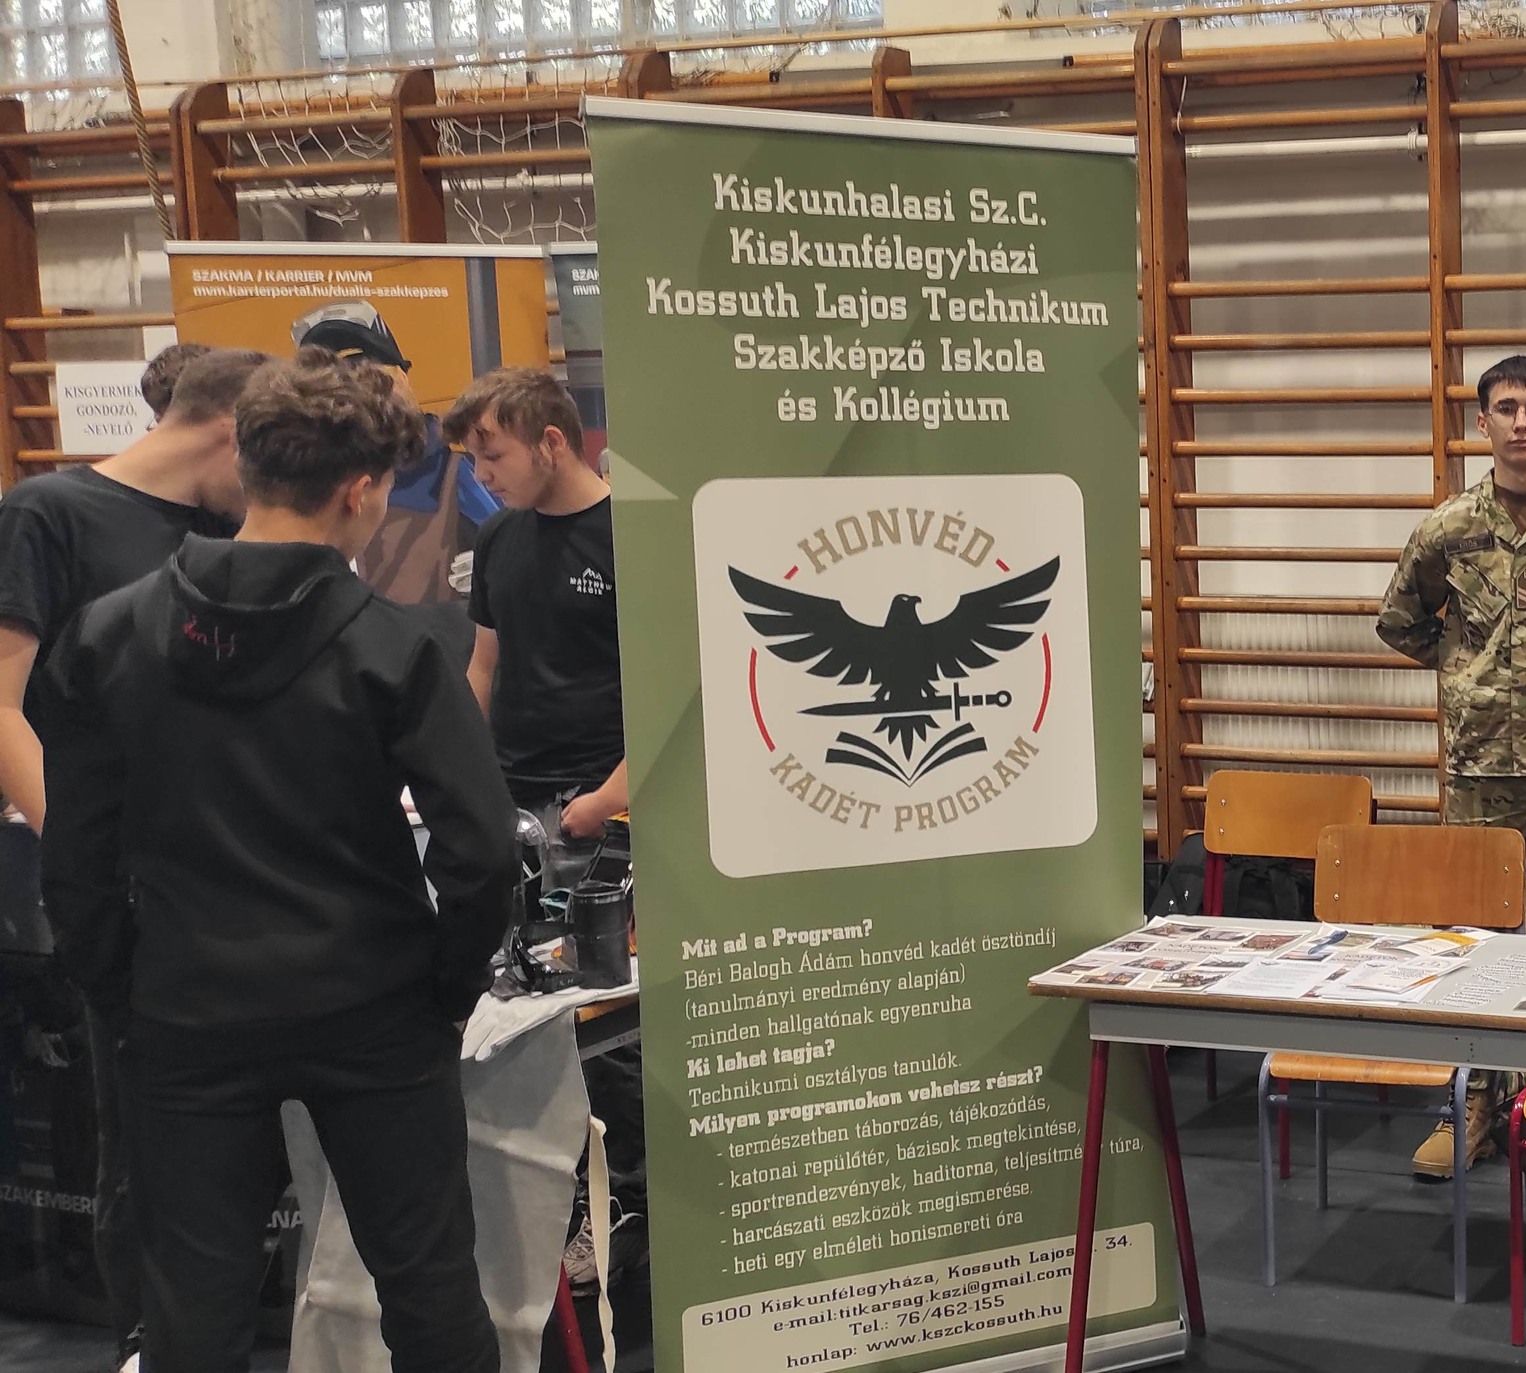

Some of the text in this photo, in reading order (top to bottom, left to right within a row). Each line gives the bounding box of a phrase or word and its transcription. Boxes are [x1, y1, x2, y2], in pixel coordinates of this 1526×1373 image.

[713, 173, 1047, 226] Kiskunhalasi Sz.C.
[192, 269, 253, 282] SZAKMA
[265, 270, 324, 283] KARRIER
[336, 270, 372, 283] MVM
[729, 227, 1039, 280] Kiskunfélegyházi
[646, 277, 1109, 328] Kossuth Lajos Technikum
[734, 333, 1045, 379] Szakképző Iskola
[777, 386, 1010, 430] és Kollégium
[797, 508, 995, 574] HONVÉD
[769, 736, 1039, 832] KADÉT PROGRAM
[681, 919, 873, 960] Mit ad a Program?
[684, 927, 1056, 990] Béri Balogh Ádám honvéd kadét ösztöndíj
[685, 963, 965, 1020] (tanulmányi eredmény alapján)
[686, 994, 972, 1048] -minden hallgatónak egyenruha
[687, 1039, 835, 1078] Ki lehet tagja?
[689, 1051, 962, 1108] Technikumi osztályos tanulók.
[689, 1066, 1043, 1137] Milyen programokon vehetsz részt?
[728, 1127, 849, 1158] természetben
[855, 1112, 943, 1138] táborozás,
[950, 1095, 1050, 1125] tájékozódás,
[730, 1161, 798, 1188] katonai
[804, 1149, 890, 1176] repülőtér,
[896, 1135, 961, 1161] bázisok
[967, 1119, 1081, 1149] megtekintése,
[731, 1172, 907, 1219] sportrendezvények,
[913, 1160, 998, 1187] haditorna,
[1004, 1143, 1104, 1172] teljesítmé
[1109, 1136, 1145, 1155] túra,
[732, 1214, 826, 1246] harcászati
[832, 1199, 912, 1228] eszközök
[918, 1182, 1033, 1213] megismerése.
[734, 1253, 768, 1275] heti
[774, 1249, 807, 1269] egy
[813, 1233, 883, 1260] elméleti
[890, 1214, 991, 1247] honismereti
[996, 1210, 1023, 1228] óra
[702, 1304, 751, 1326] 6100
[761, 1273, 940, 1314] Kiskunfélegyháza,
[948, 1255, 1020, 1280] Kossuth
[1029, 1247, 1075, 1265] Lajos
[1105, 1234, 1133, 1250] 34.
[773, 1266, 1073, 1332] e-mail:titkarsag.kszi@gmail.com
[787, 1303, 1063, 1368] honlap: www.kszckossuth.hu
[849, 1295, 1005, 1336] Tel.: 76/462-155
